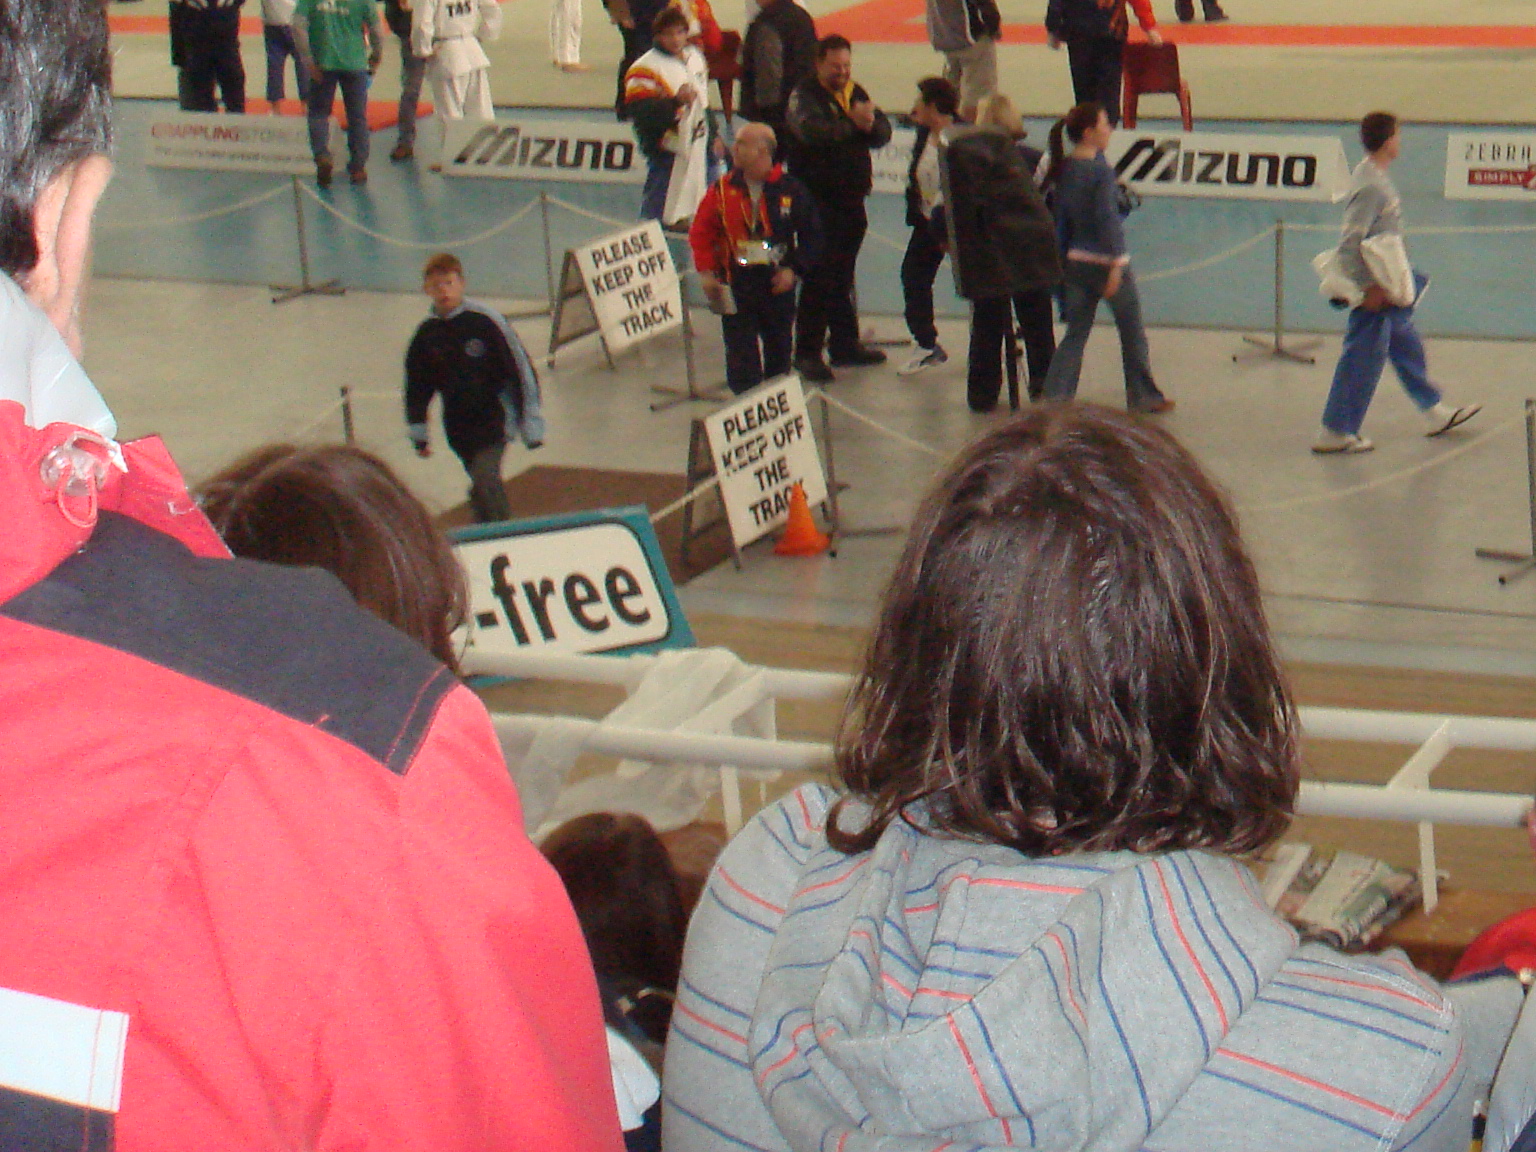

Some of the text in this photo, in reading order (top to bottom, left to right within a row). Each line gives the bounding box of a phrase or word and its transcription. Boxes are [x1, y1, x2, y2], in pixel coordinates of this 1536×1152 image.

[1465, 142, 1531, 161] ZEBRA
[592, 231, 652, 269] PLEASE
[592, 251, 666, 296] KEEP OFF
[623, 283, 653, 310] THE
[621, 302, 674, 336] TRACK
[723, 389, 790, 443] PLEASE
[721, 415, 804, 477] KEEP OFF
[753, 456, 790, 491] THE
